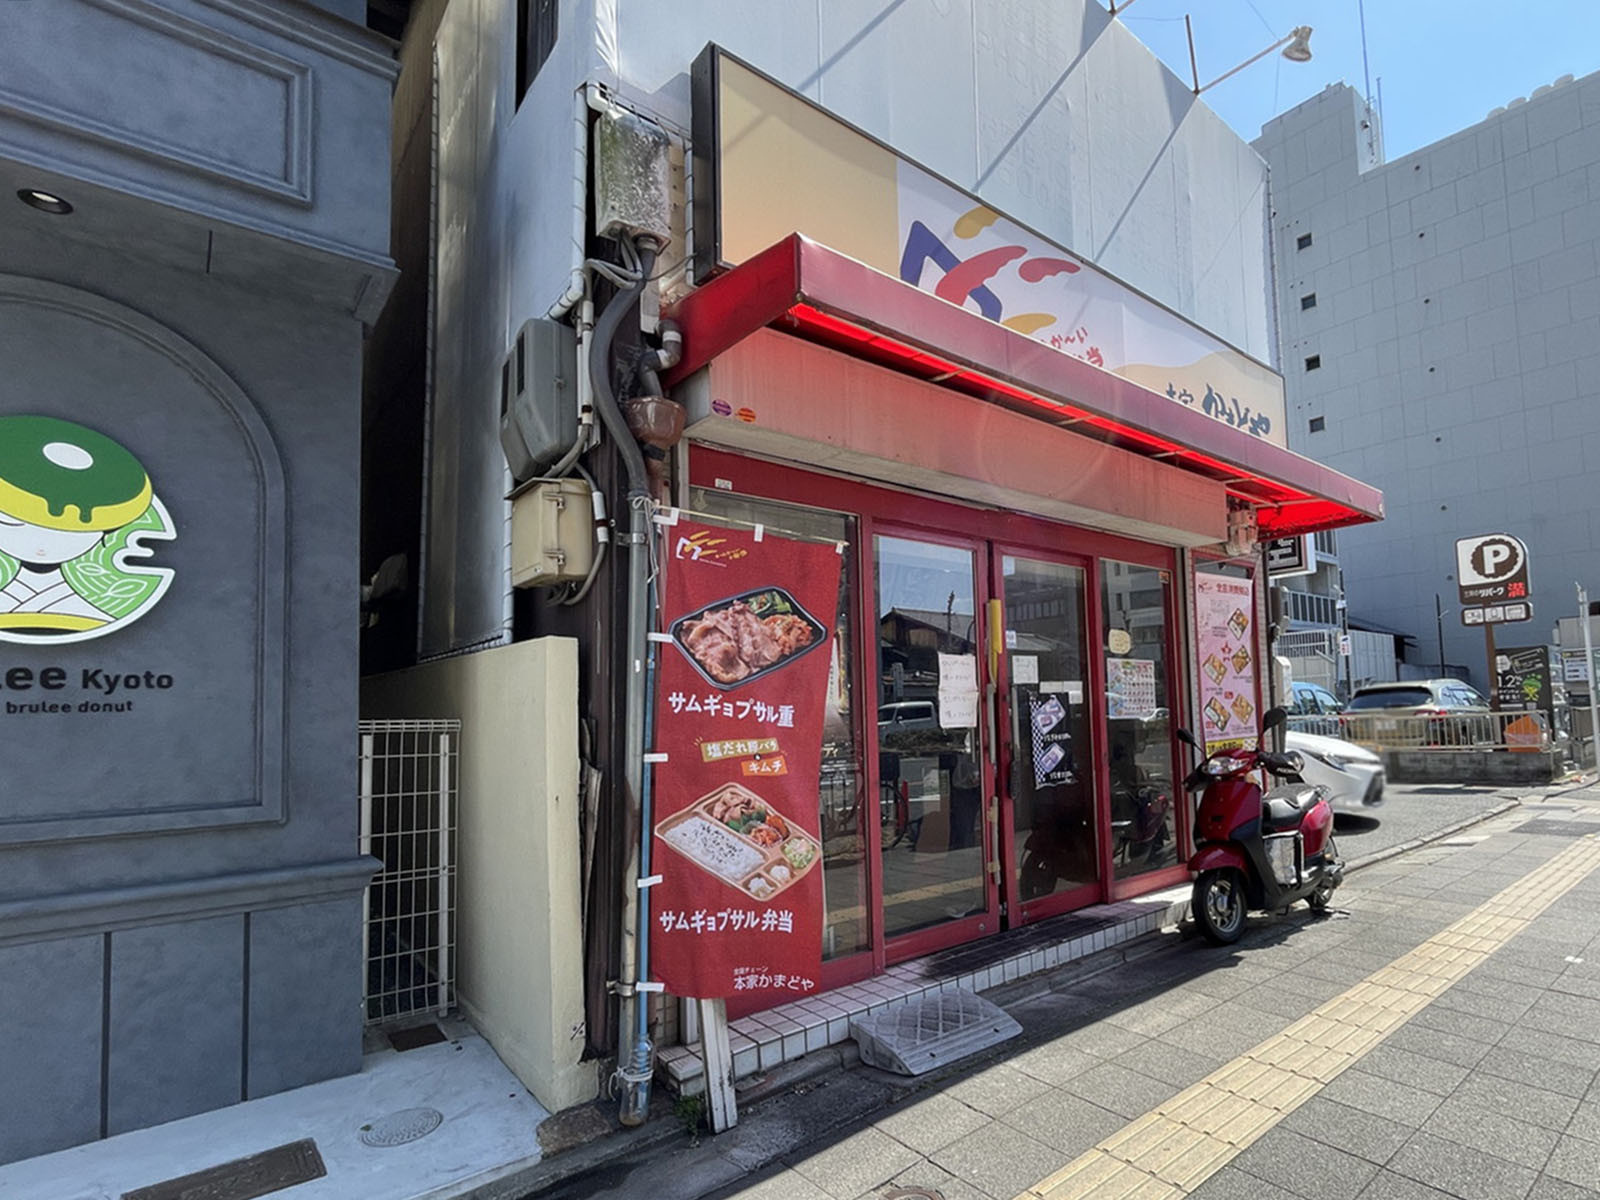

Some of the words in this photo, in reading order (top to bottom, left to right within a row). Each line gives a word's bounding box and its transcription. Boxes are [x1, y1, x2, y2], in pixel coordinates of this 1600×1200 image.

[1482, 544, 1511, 575] P
[0, 667, 67, 690] ee
[82, 669, 174, 695] Kyoto
[6, 701, 71, 714] brulee
[78, 700, 133, 713] donut
[668, 692, 795, 728] サムギョプサル重
[749, 760, 782, 773] キムチ
[733, 974, 815, 991] 本家かまどや
